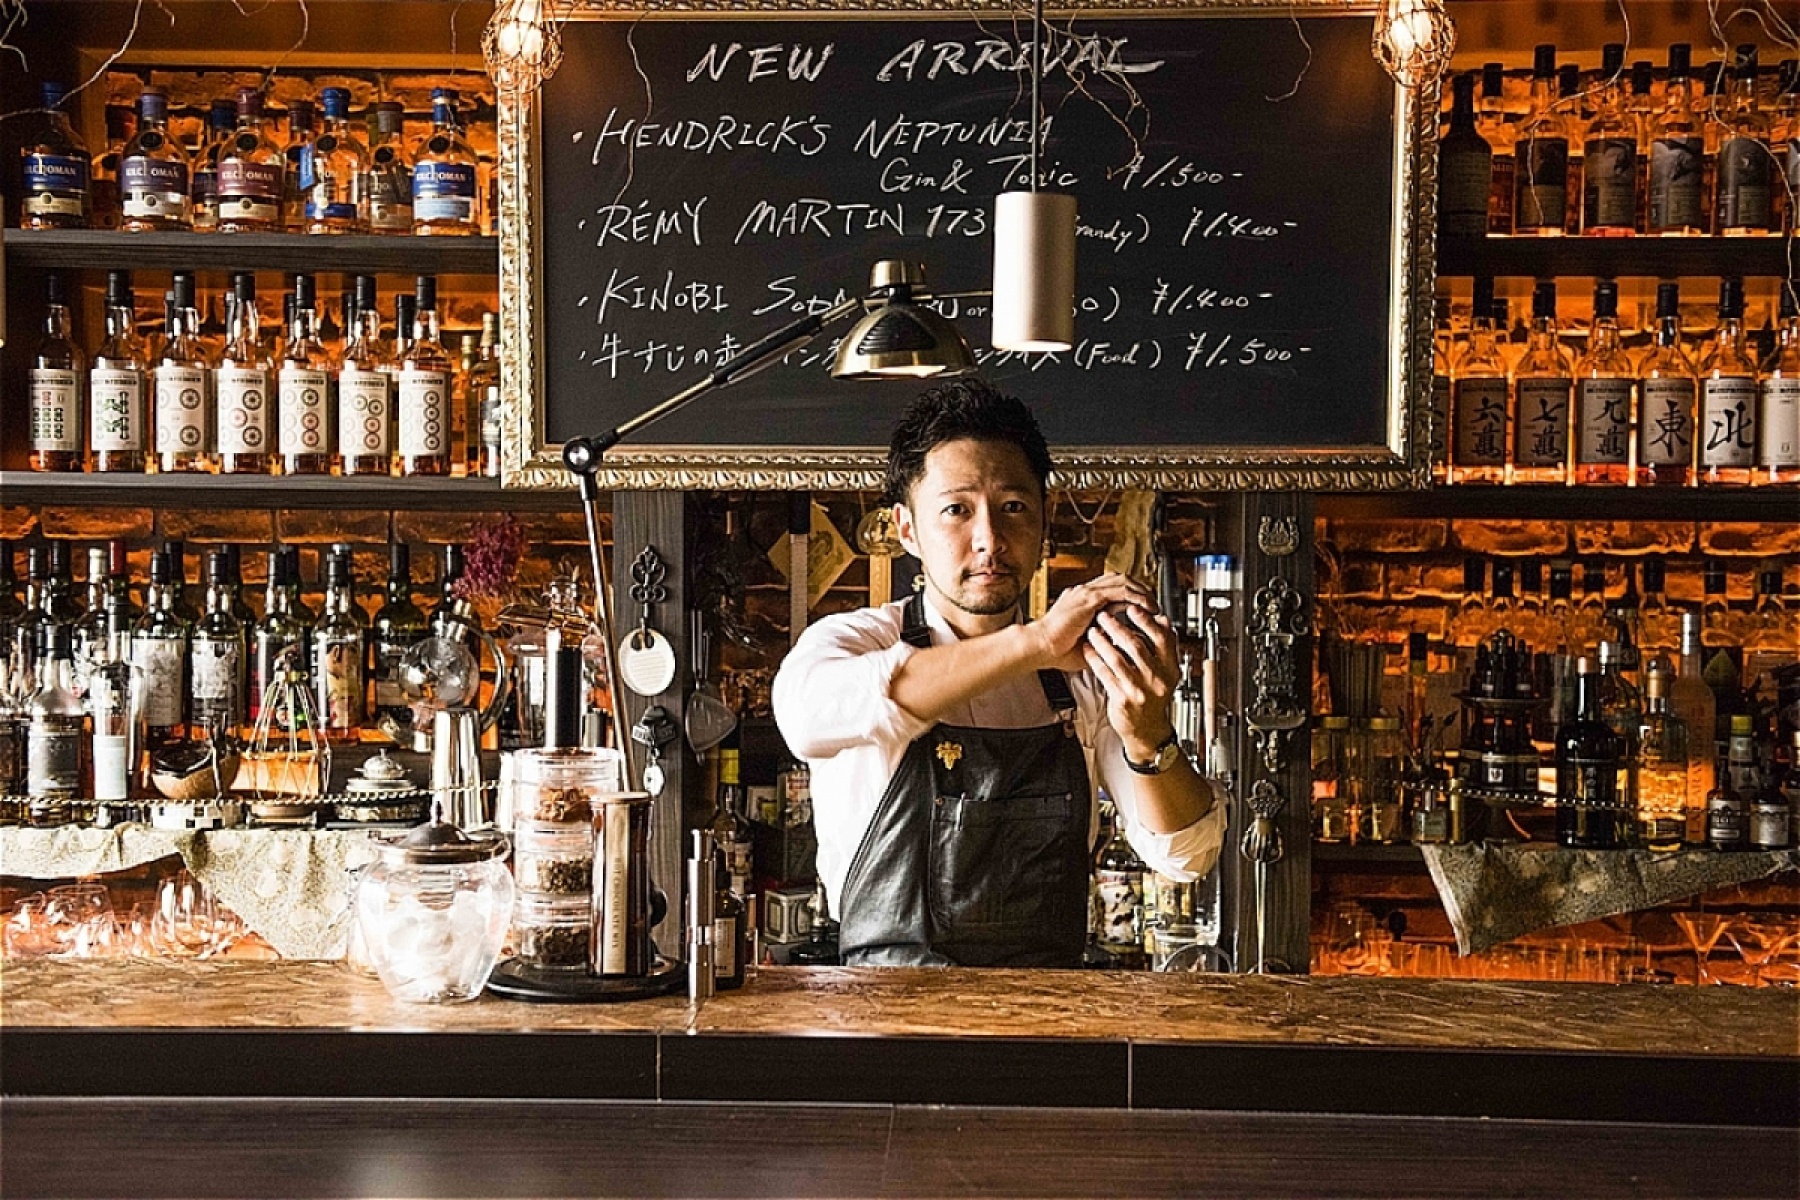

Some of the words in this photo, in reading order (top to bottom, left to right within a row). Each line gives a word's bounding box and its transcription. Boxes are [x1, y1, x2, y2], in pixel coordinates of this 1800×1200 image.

[686, 42, 835, 83] NEW
[875, 33, 1165, 82] ARRIVAL
[591, 107, 832, 165] HENDRICK'S
[597, 196, 708, 246] RÉMY
[735, 199, 905, 245] MARTIN
[1650, 399, 1689, 459] 東
[1706, 400, 1753, 451] 北
